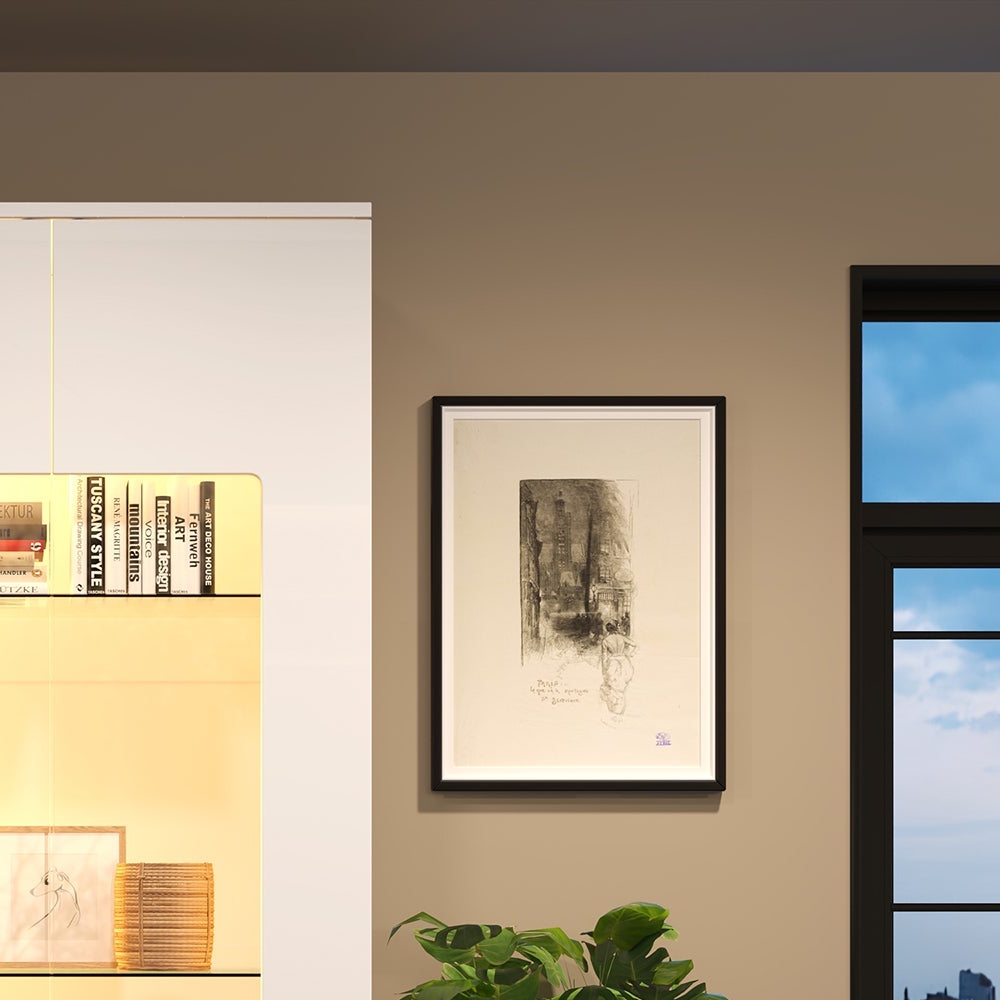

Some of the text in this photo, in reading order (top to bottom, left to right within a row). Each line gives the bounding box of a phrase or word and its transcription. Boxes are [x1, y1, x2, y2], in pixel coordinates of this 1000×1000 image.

[91, 478, 102, 586] TUSCANY STYLE
[114, 498, 122, 518] RENÉ
[175, 516, 185, 542] ART
[129, 504, 140, 582] mountains
[145, 520, 154, 558] voice
[156, 500, 170, 592] Interior design
[189, 513, 200, 568] Fernweh
